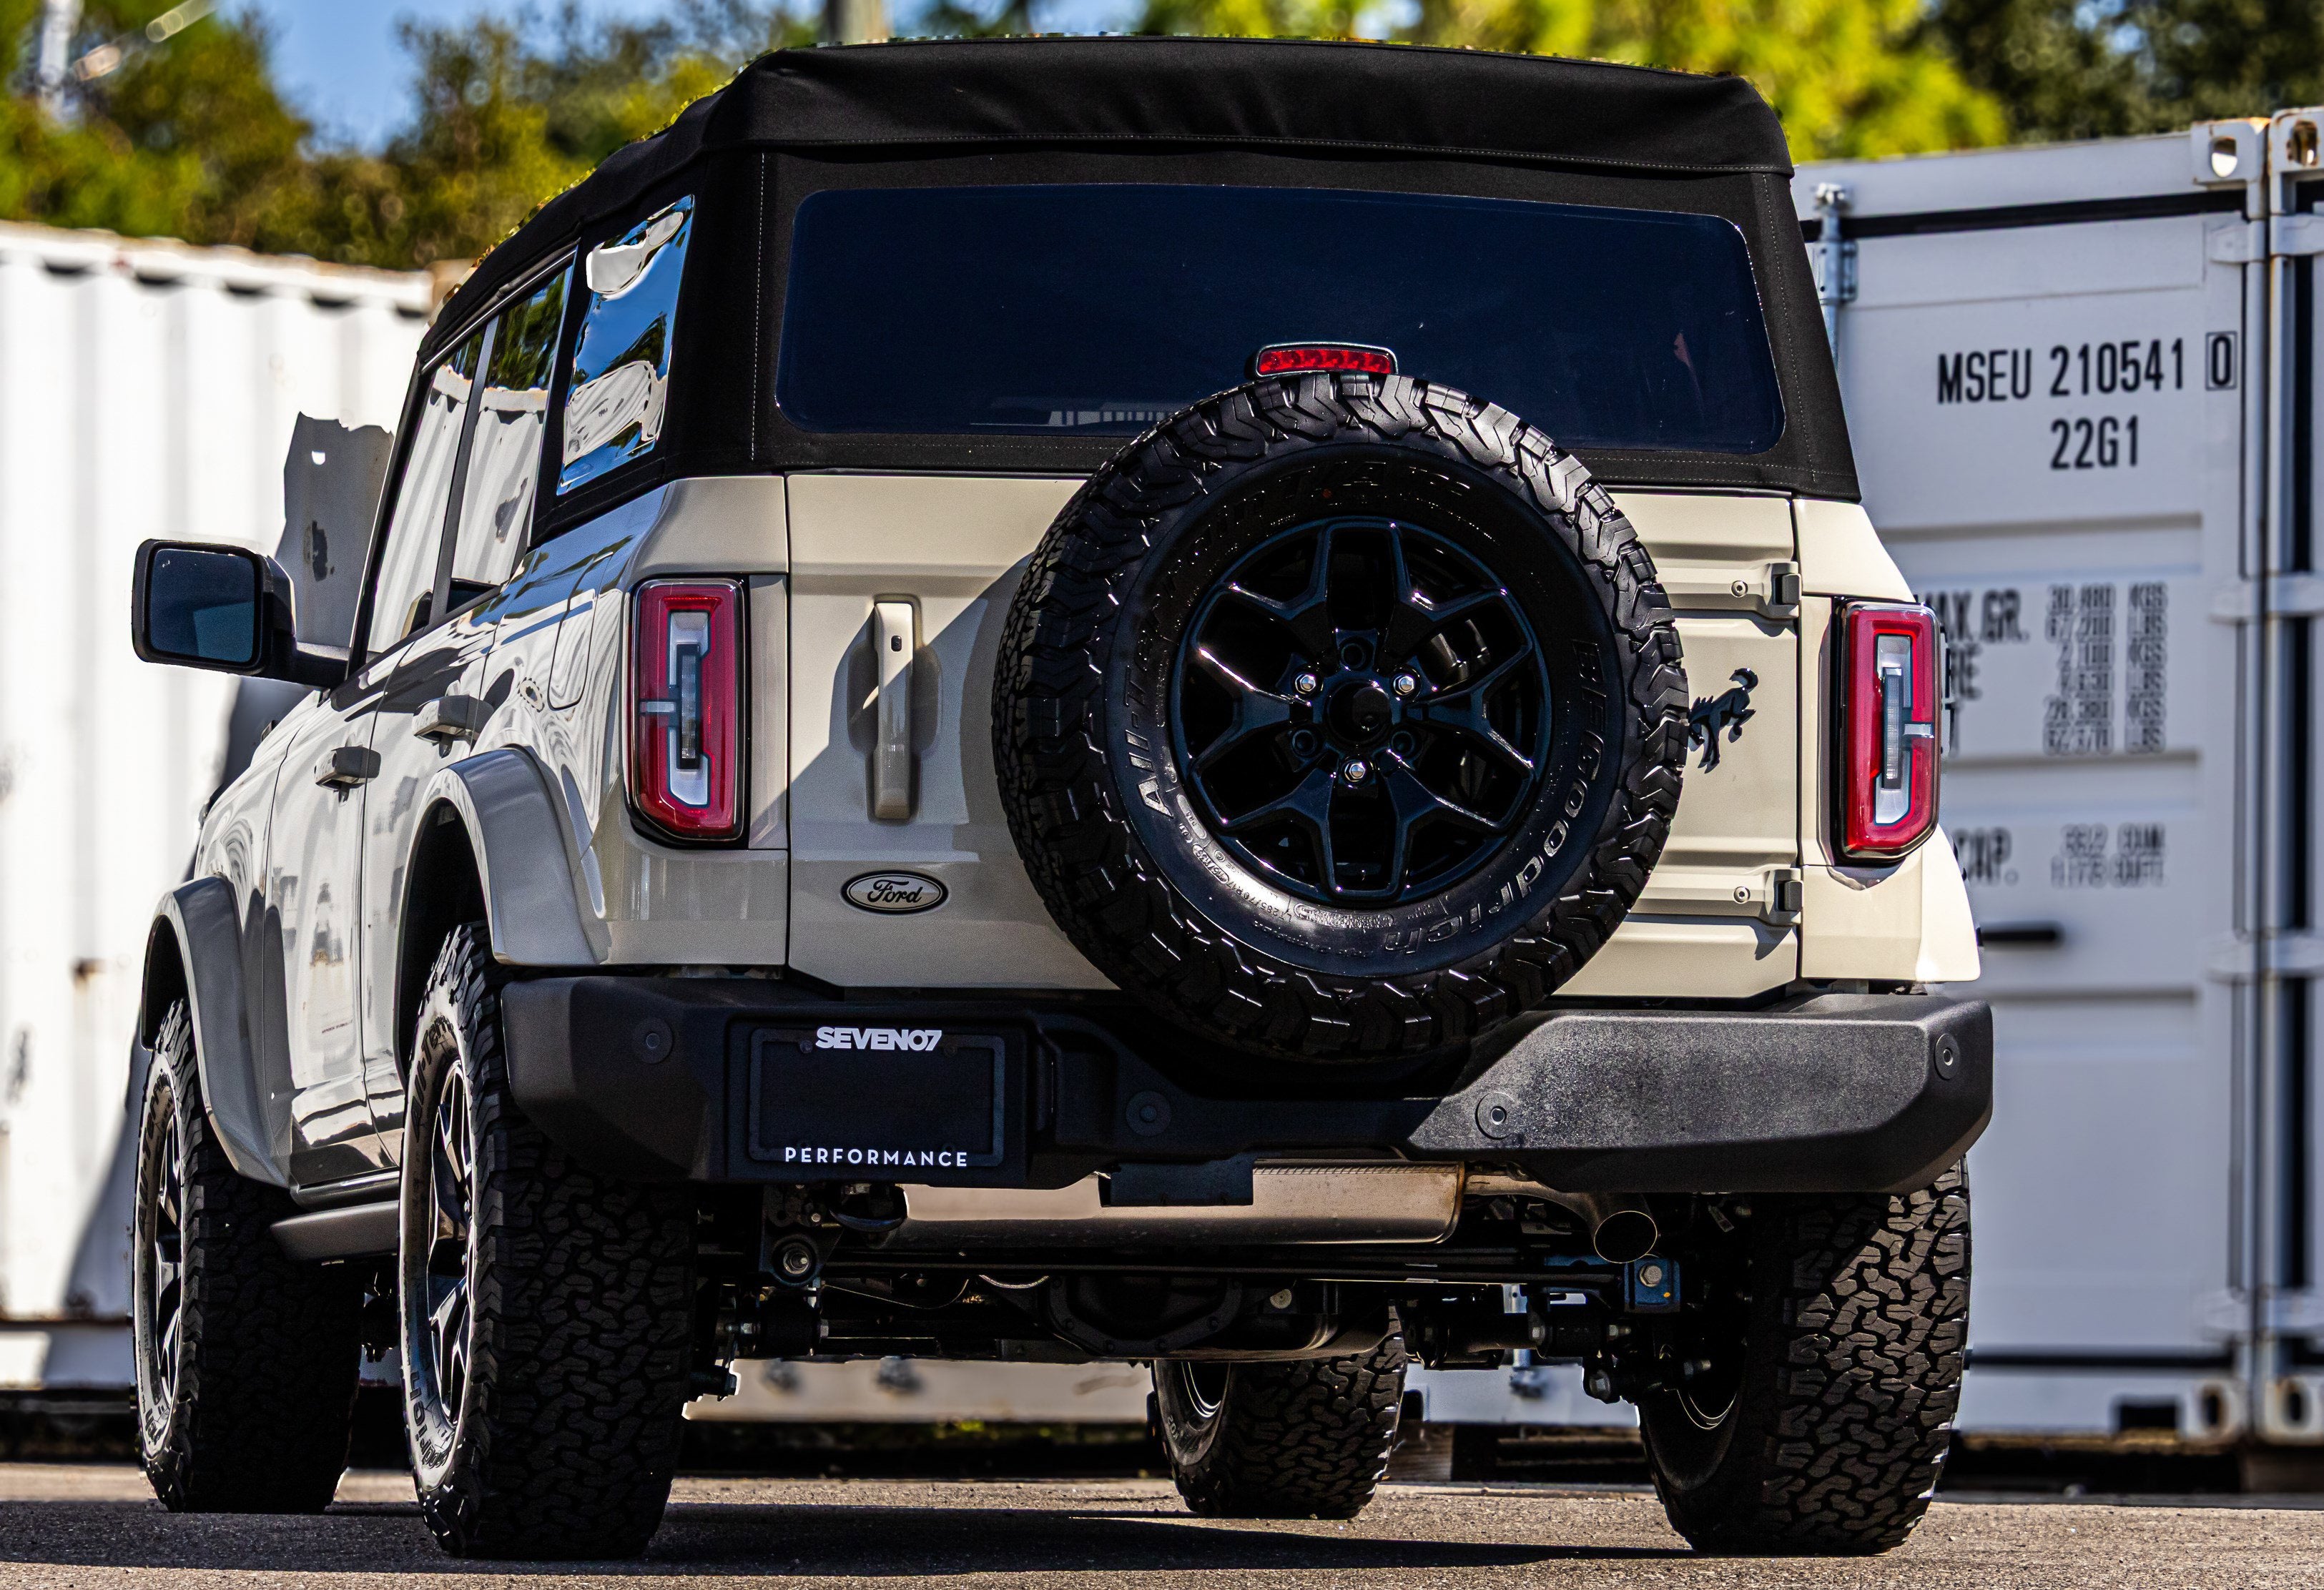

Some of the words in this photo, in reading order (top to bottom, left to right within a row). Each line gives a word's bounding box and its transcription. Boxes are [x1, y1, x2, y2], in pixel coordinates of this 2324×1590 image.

[1938, 348, 2032, 405] MSEU
[2049, 337, 2183, 398] 210541
[2211, 335, 2232, 388] 0
[2051, 415, 2138, 470] 22G1
[1385, 639, 1606, 954] BFGoodrich
[867, 879, 922, 904] Ford
[784, 1147, 968, 1167] PERFORMANCE
